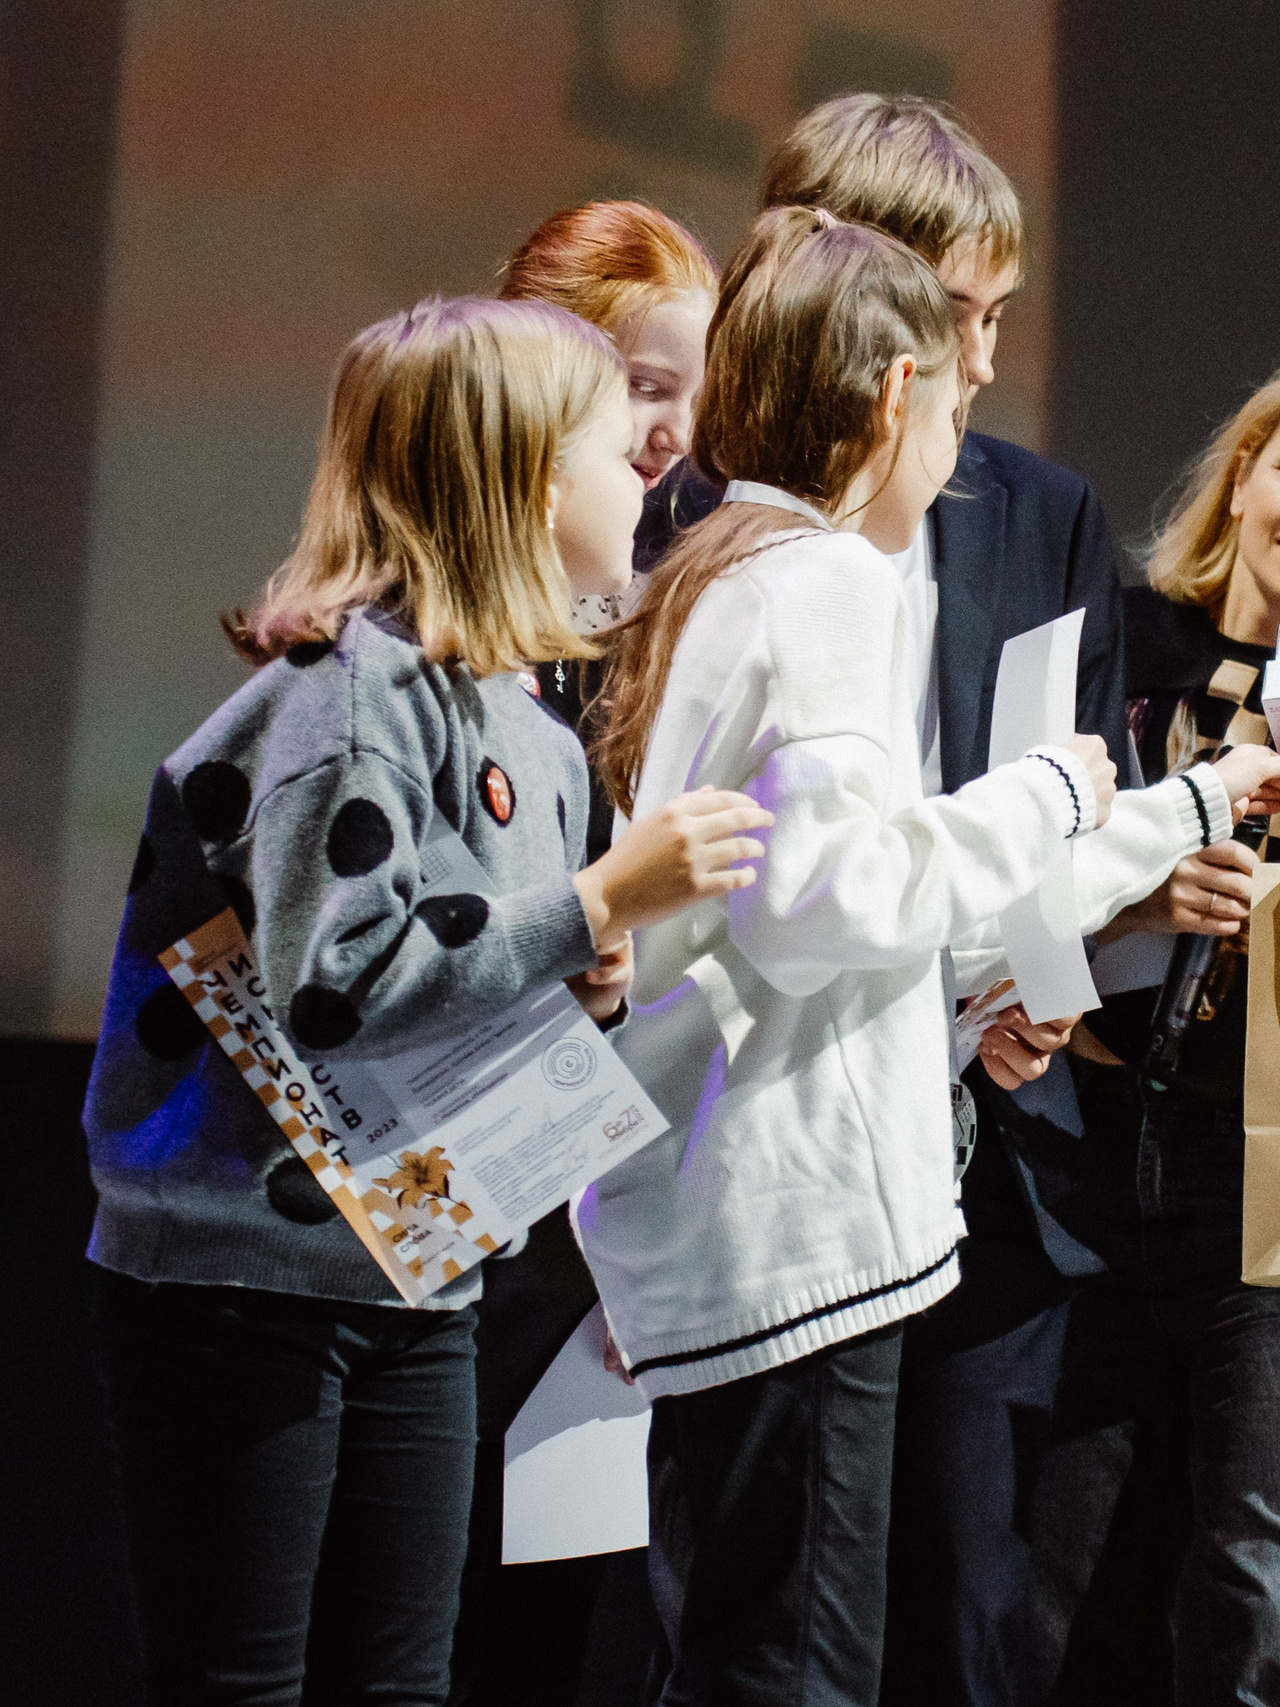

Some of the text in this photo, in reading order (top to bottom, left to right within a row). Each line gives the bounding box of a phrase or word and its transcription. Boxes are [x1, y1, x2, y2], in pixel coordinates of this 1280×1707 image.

[198, 969, 350, 1167] ЧЕМПИОНАТ
[227, 952, 363, 1131] ИССТВ
[366, 1118, 398, 1144] 2023
